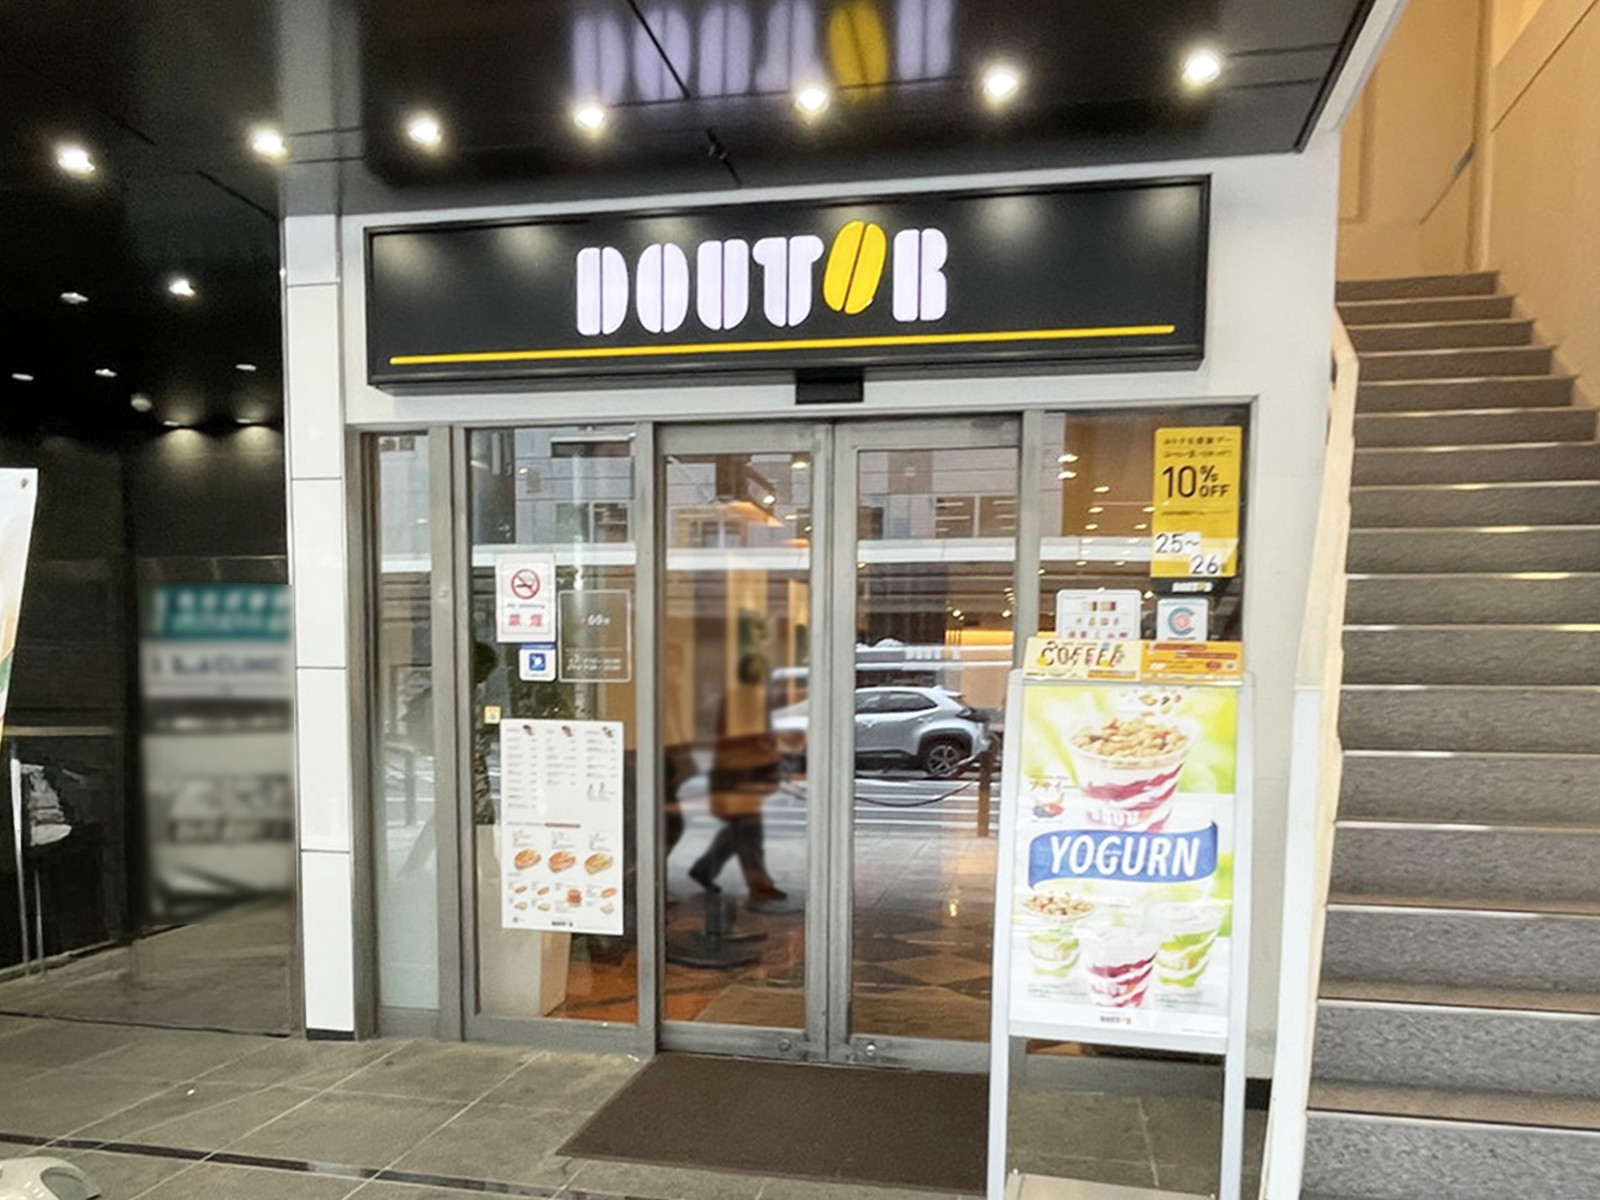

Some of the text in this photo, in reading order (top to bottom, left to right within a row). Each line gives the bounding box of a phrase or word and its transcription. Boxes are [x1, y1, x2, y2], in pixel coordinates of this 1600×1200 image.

[576, 220, 949, 336] DOUTOR
[1162, 464, 1219, 499] 10%
[1199, 484, 1231, 498] OFF
[1192, 554, 1219, 575] 26
[1039, 641, 1125, 668] COFFEE
[1050, 834, 1201, 878] YOGURN
